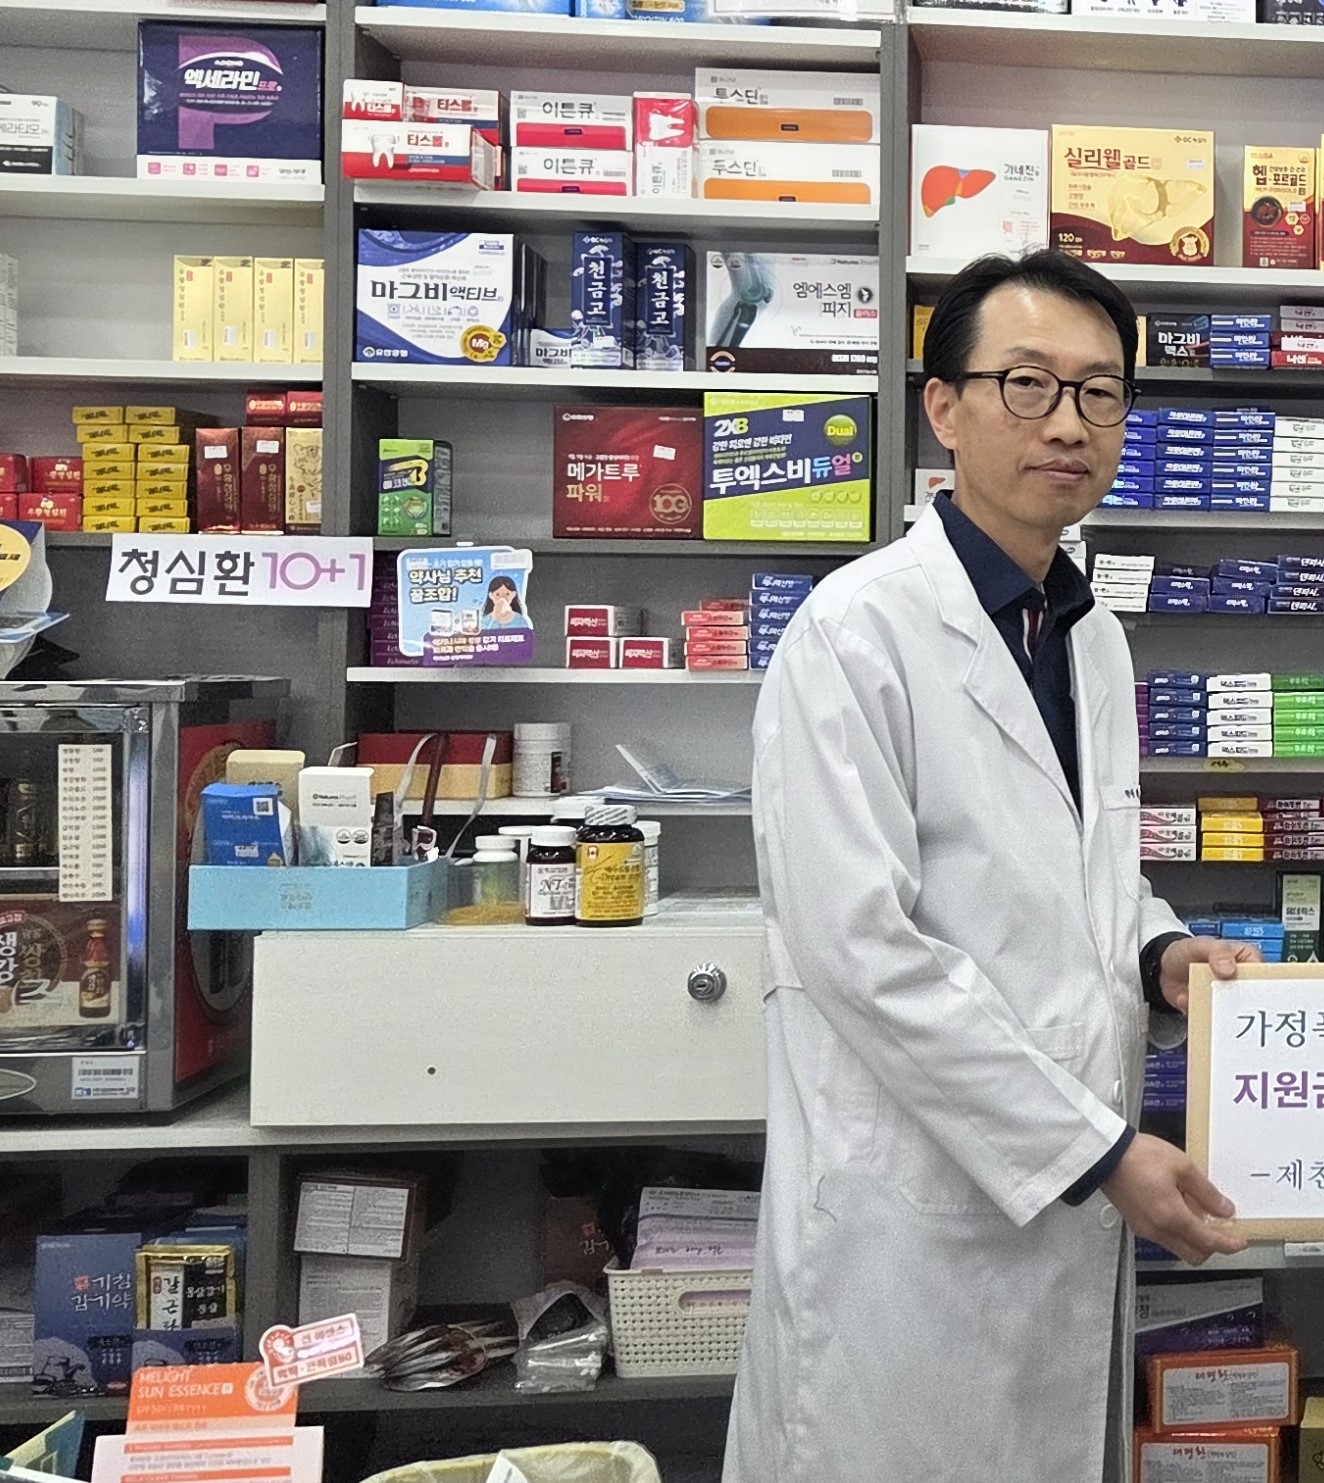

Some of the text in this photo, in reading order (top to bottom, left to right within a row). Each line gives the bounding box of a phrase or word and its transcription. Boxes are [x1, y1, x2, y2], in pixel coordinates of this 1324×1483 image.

[184, 69, 260, 91] 엑세라민
[1064, 147, 1120, 169] 실리웰
[371, 280, 448, 302] 마그비
[587, 260, 607, 317] 천금고
[651, 270, 670, 326] 천금고
[793, 282, 852, 299] 엠에스엠
[821, 301, 852, 318] 피지
[1158, 332, 1200, 346] 마그비
[826, 426, 854, 437] Dual
[567, 462, 641, 481] 메가트루
[709, 457, 812, 495] 투엑스비
[566, 483, 602, 502] 파워
[118, 548, 367, 597] 청심환 10+1
[409, 567, 483, 584] 약사님 추천
[91, 1273, 132, 1291] 기침
[71, 1293, 133, 1314] 감기약
[138, 1382, 221, 1399] SUN ESSENCE
